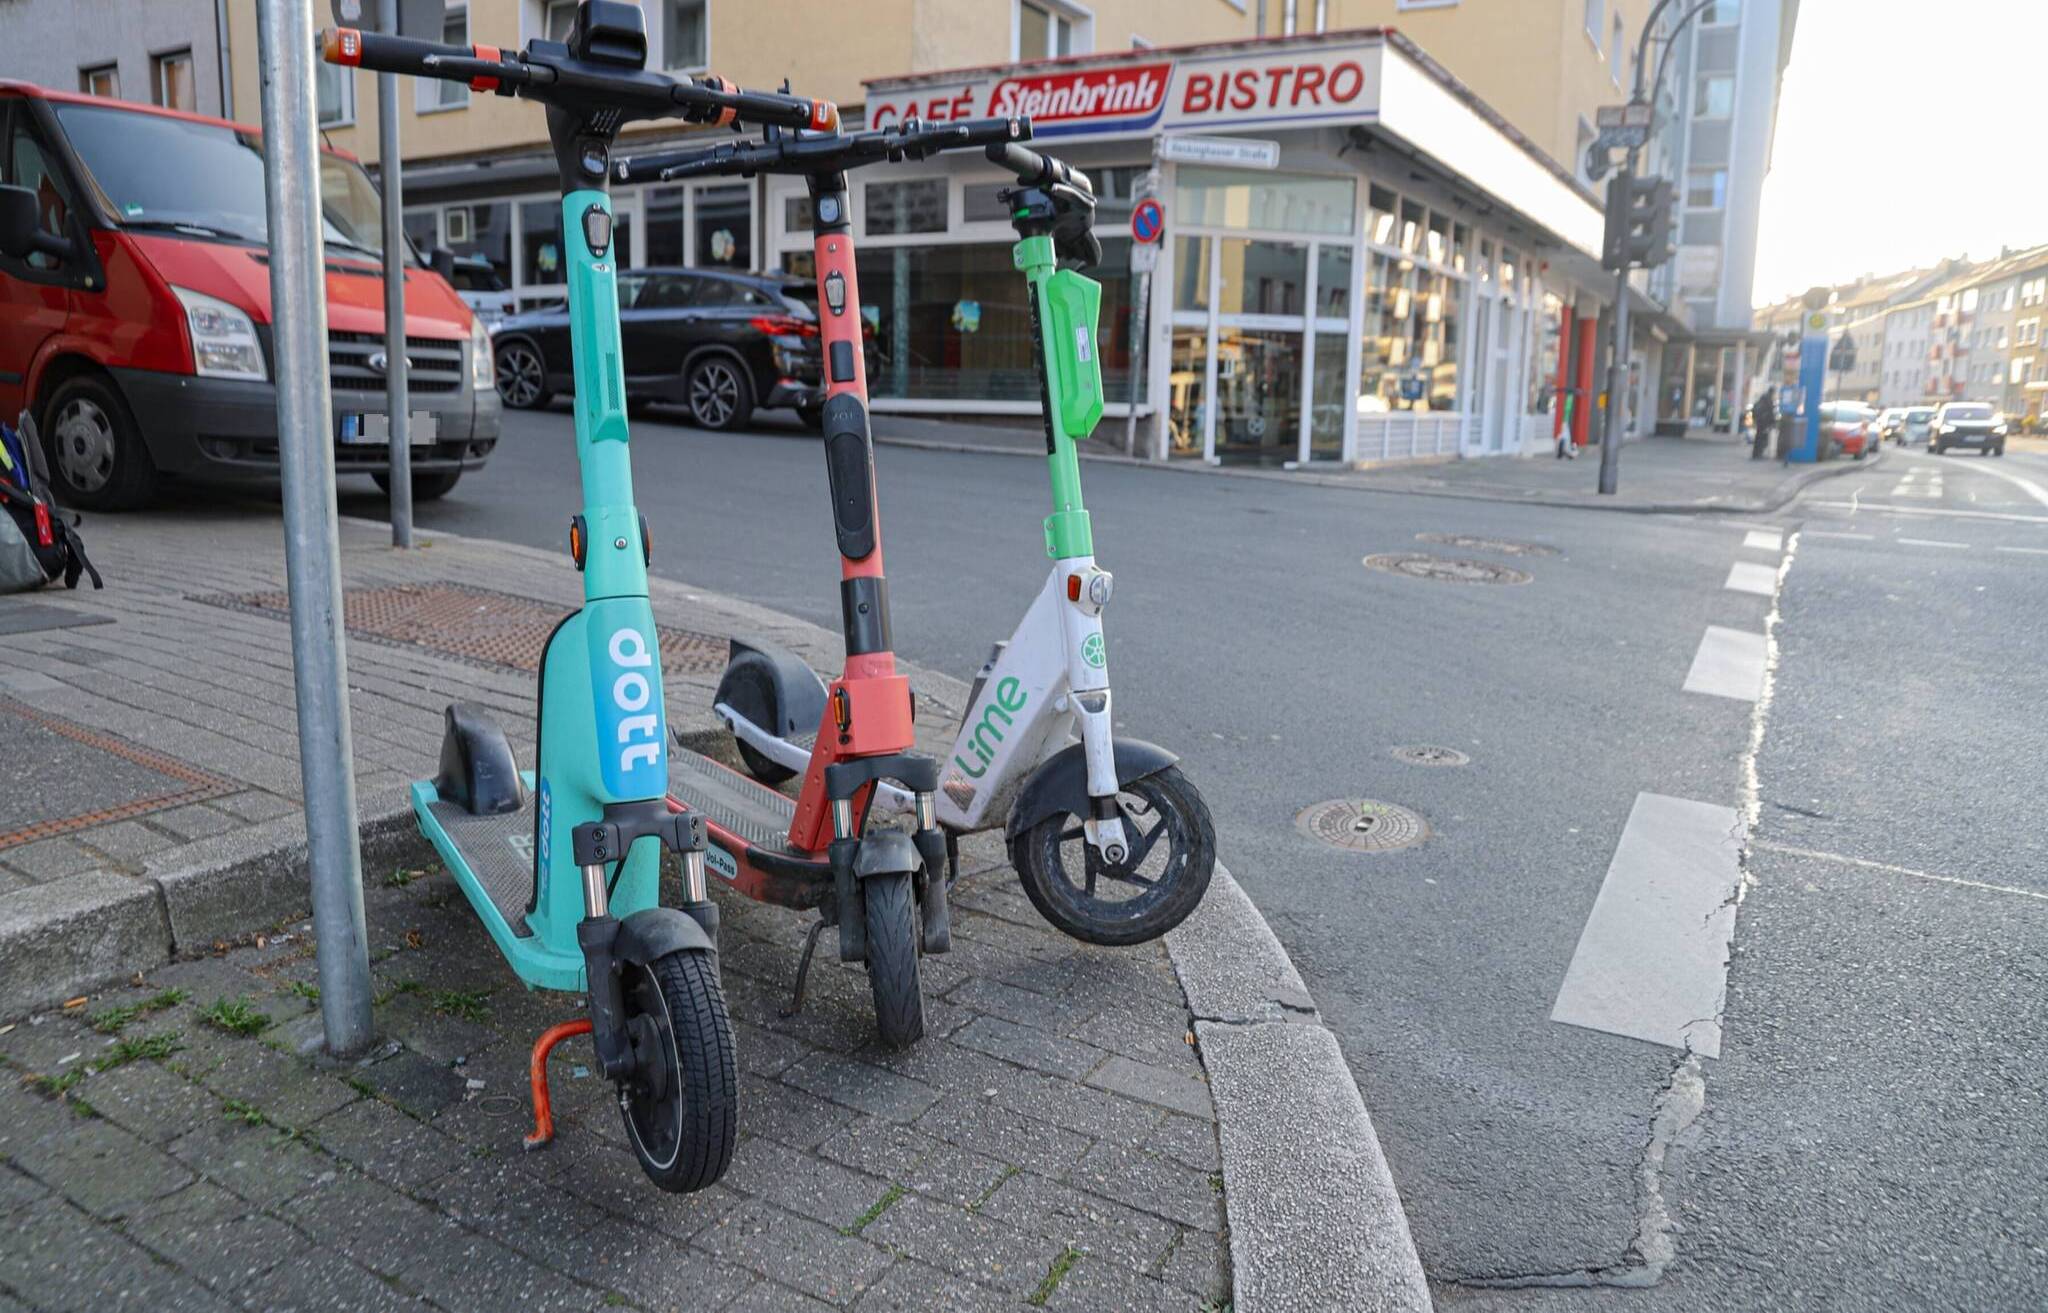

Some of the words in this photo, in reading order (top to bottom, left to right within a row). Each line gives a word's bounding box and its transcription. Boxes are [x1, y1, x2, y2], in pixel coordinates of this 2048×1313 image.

[992, 69, 1158, 117] Steinbrink
[1182, 60, 1365, 114] BISTRO
[608, 628, 660, 772] dott
[541, 791, 551, 860] dott
[705, 850, 735, 876] Voi-Pass
